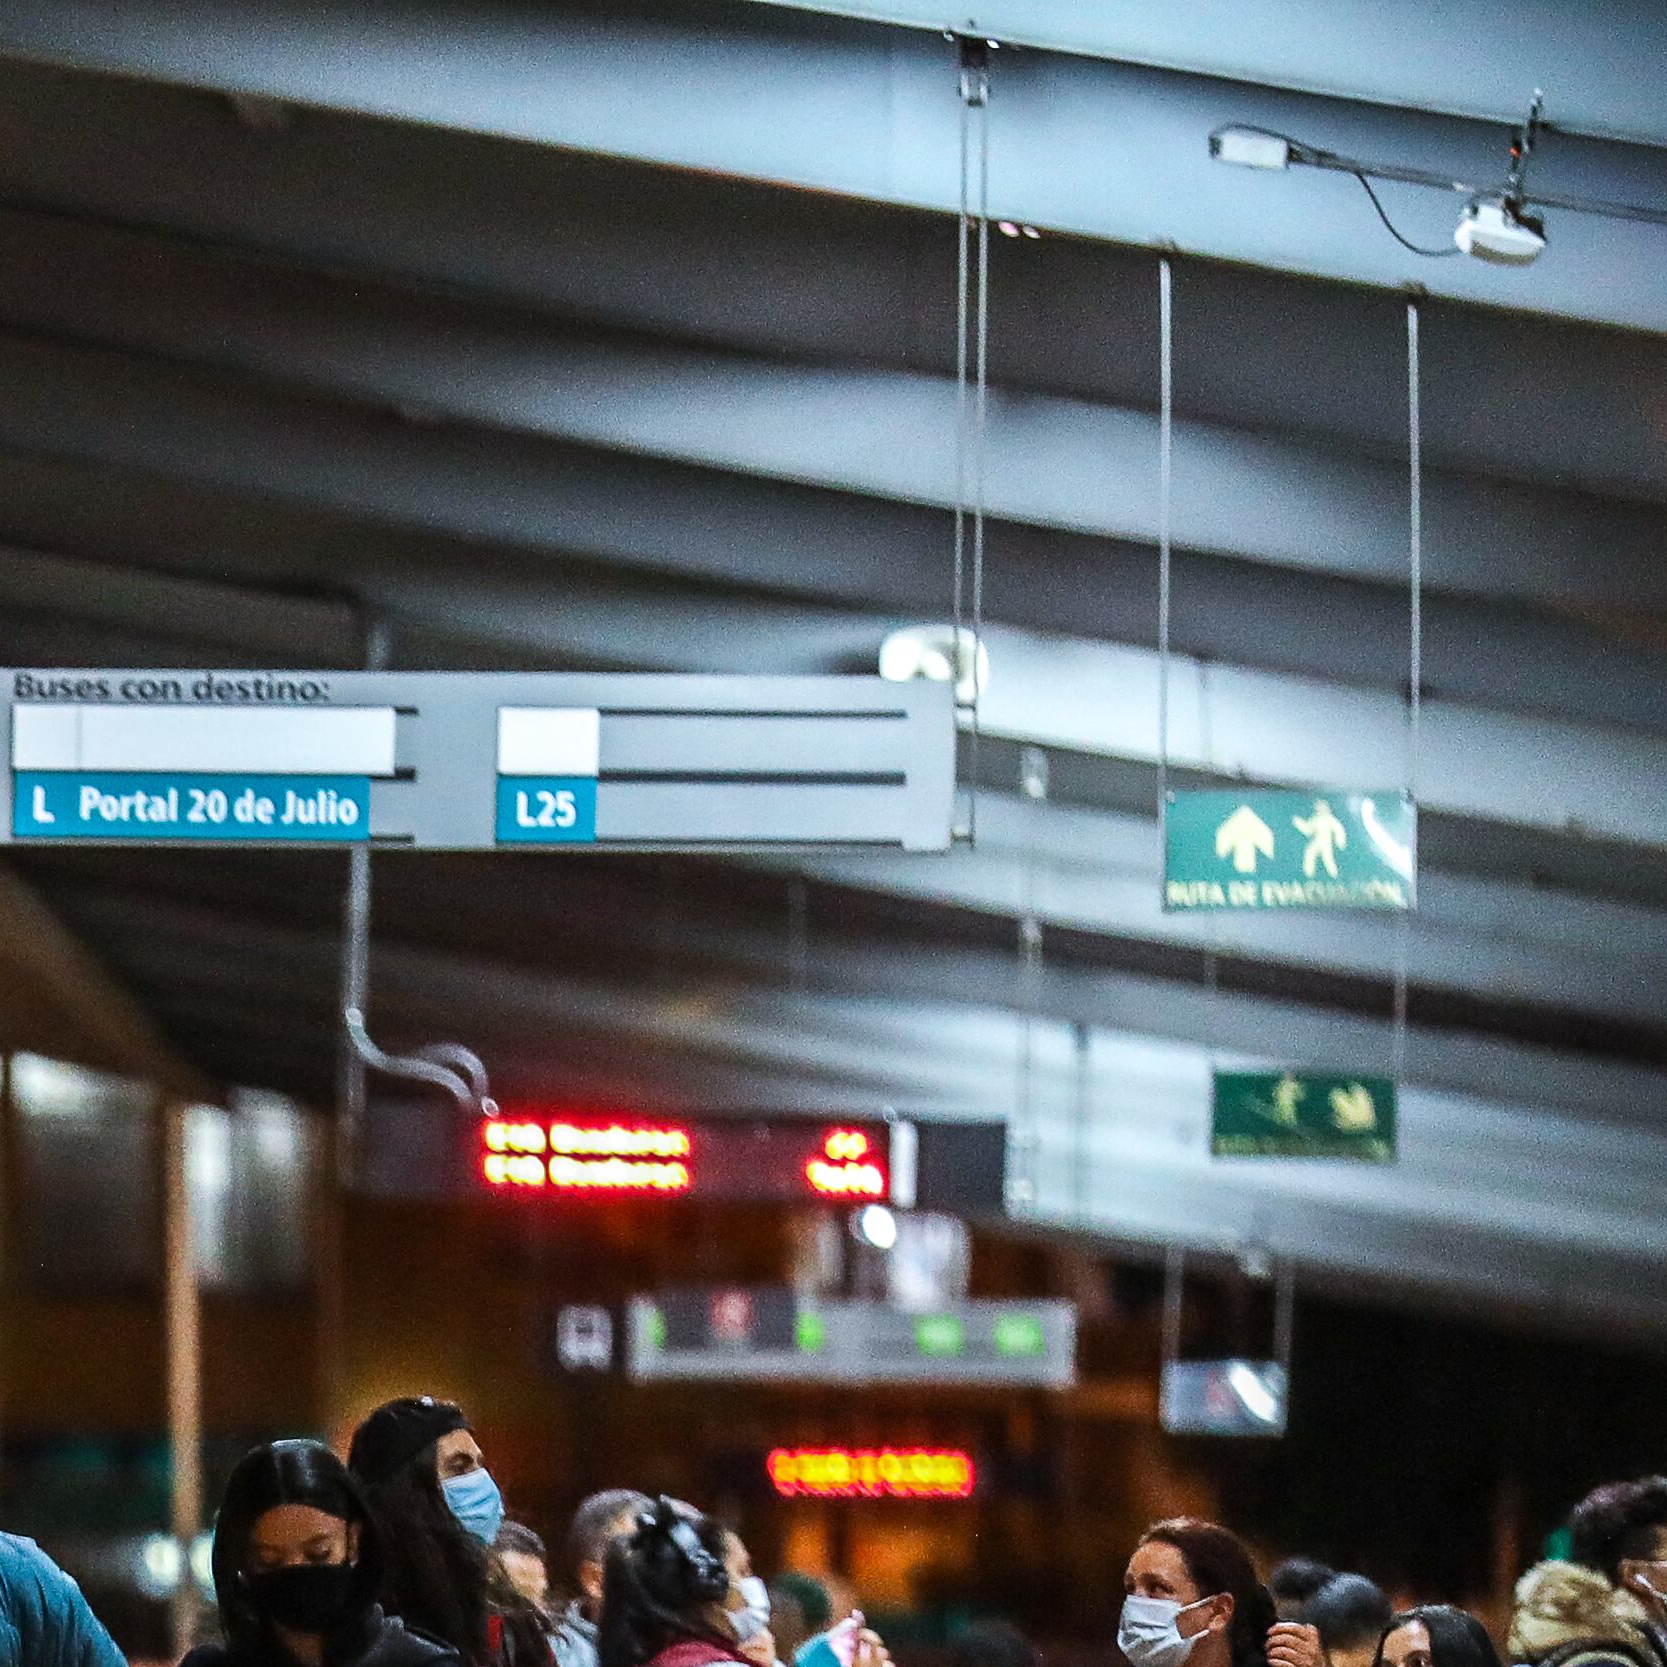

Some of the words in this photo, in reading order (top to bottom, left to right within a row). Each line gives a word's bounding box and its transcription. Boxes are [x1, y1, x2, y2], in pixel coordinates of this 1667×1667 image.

[14, 672, 110, 701] Buses
[119, 678, 183, 701] con
[192, 672, 331, 702] destino:
[33, 785, 55, 824] L
[79, 785, 178, 823] Portal
[186, 788, 228, 824] 20
[234, 788, 276, 824] de
[281, 788, 360, 826] Julio
[517, 789, 577, 828] L25
